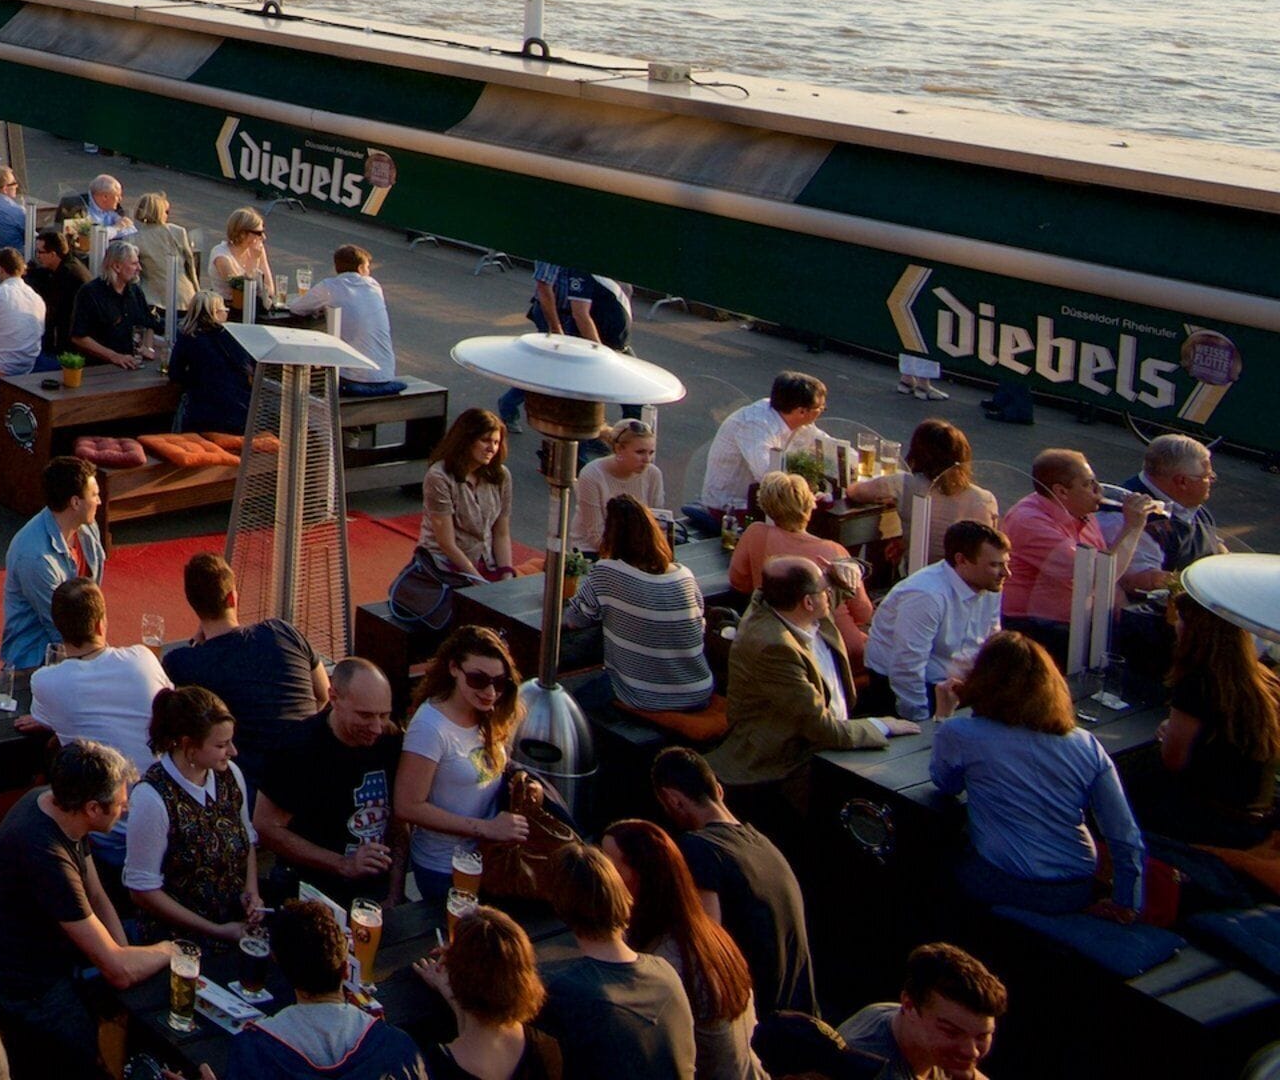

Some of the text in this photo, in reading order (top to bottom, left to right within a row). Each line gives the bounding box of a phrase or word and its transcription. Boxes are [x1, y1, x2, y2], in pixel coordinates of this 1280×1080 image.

[1060, 305, 1178, 339] Düsseldorf Rheinufer
[1194, 342, 1231, 359] WEISSE
[1192, 354, 1231, 371] FLOTTE
